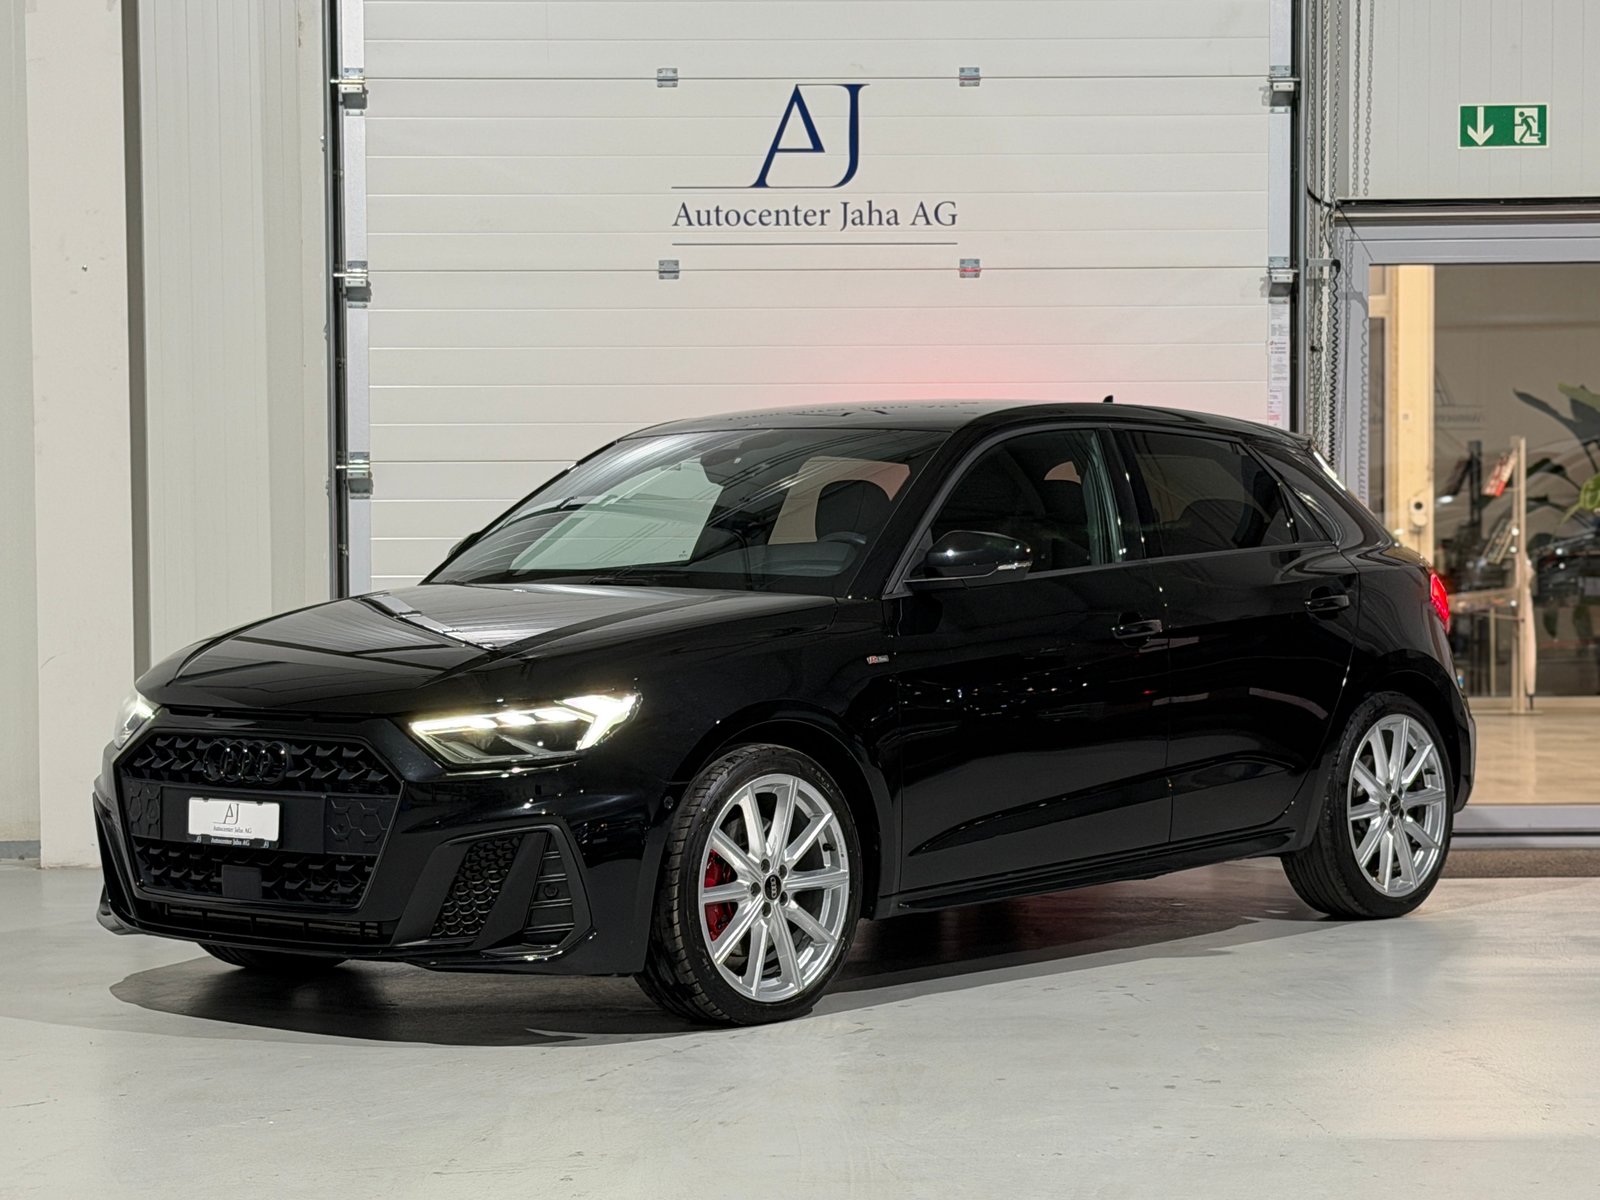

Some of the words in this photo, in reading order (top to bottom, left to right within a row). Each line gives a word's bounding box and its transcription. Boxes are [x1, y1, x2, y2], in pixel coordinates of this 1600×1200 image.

[749, 83, 870, 188] AJ
[672, 201, 831, 227] Autocenter
[840, 199, 900, 232] Jaha
[909, 200, 959, 227] AG
[223, 803, 239, 825] AJ
